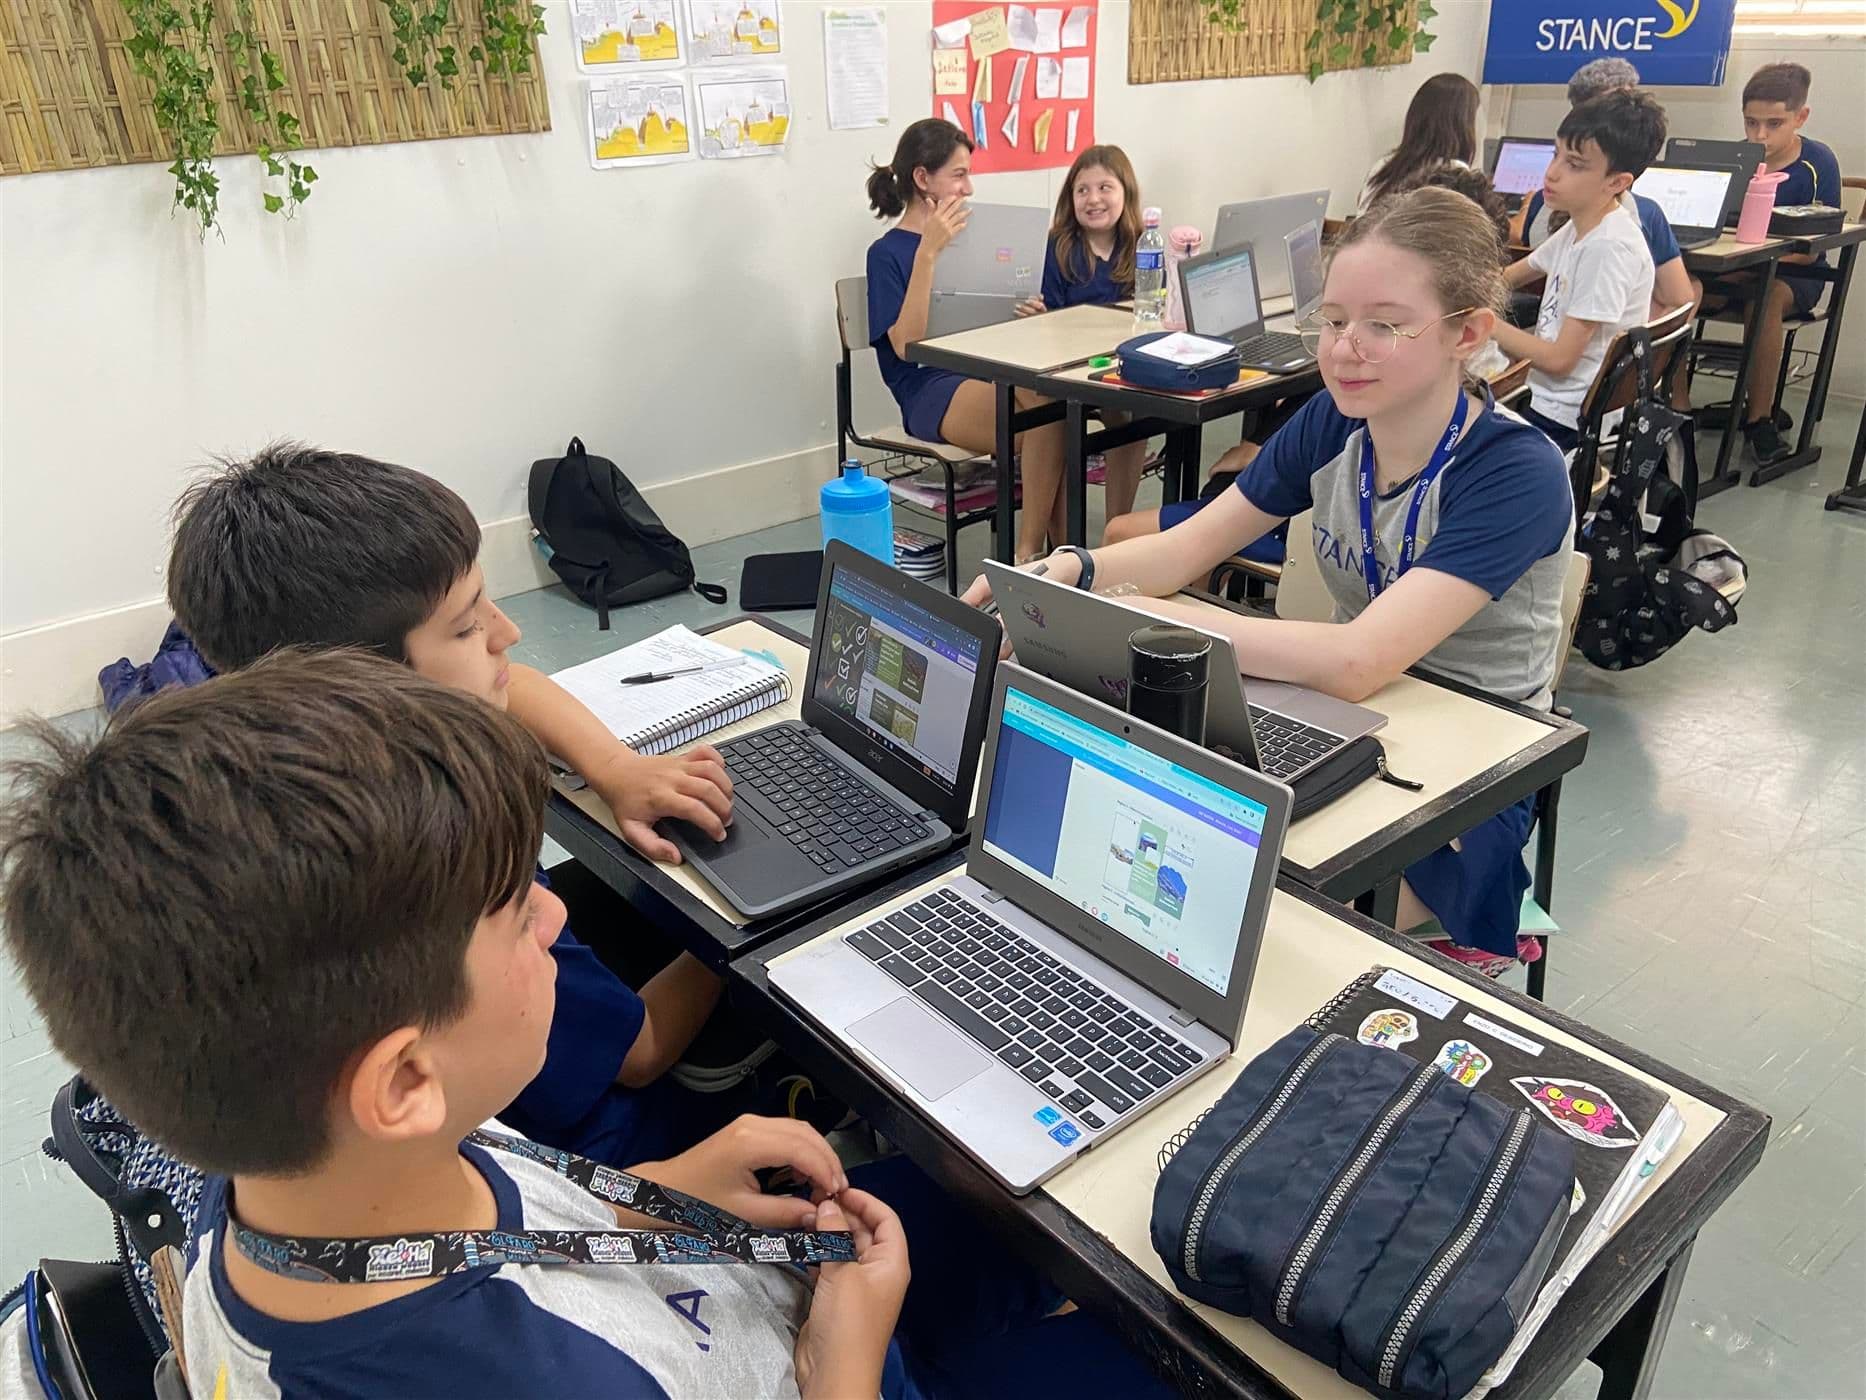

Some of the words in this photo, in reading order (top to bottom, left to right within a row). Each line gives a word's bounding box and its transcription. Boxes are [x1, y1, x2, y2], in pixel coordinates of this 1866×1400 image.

[1536, 17, 1657, 51] STANCE
[1312, 522, 1400, 590] TANE
[868, 749, 884, 763] acer
